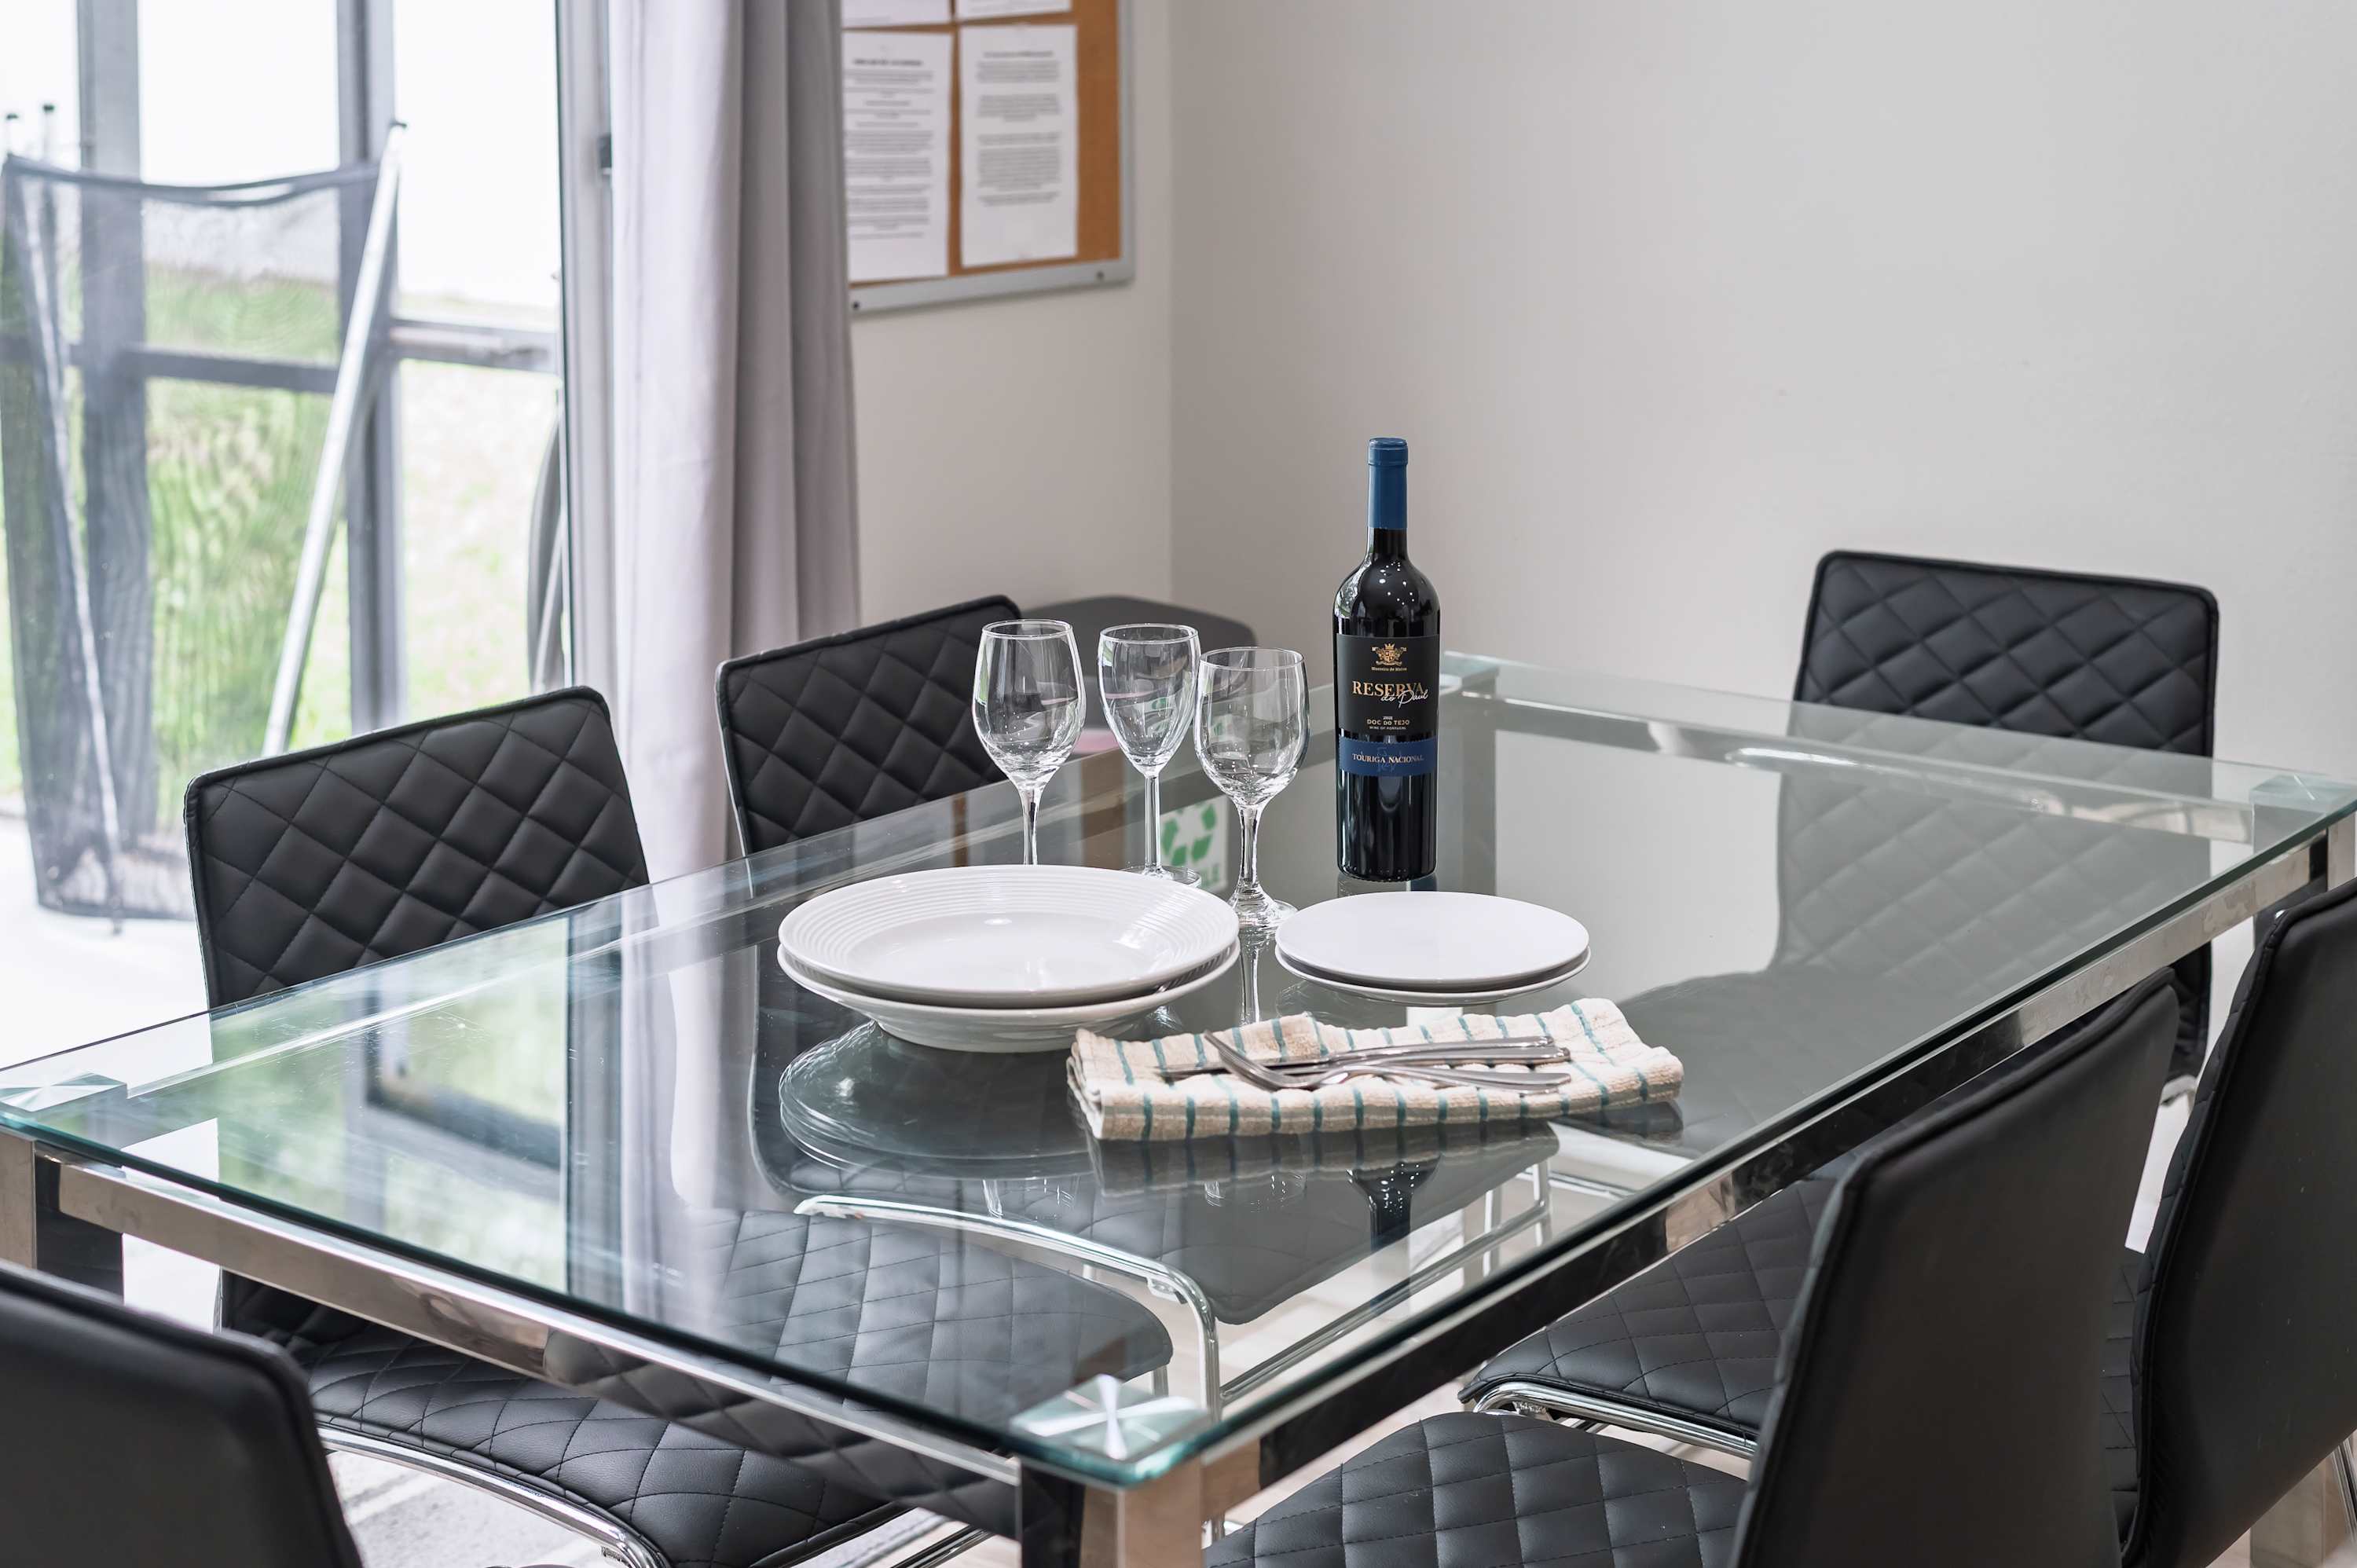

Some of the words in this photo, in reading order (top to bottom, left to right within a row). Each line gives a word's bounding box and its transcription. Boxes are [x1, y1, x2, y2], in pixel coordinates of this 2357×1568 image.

[1352, 680, 1424, 697] RESERVA
[1380, 692, 1396, 702] do
[1398, 688, 1428, 709] Paul
[1352, 753, 1386, 764] TOURIGA
[1388, 754, 1425, 764] NACIONAL
